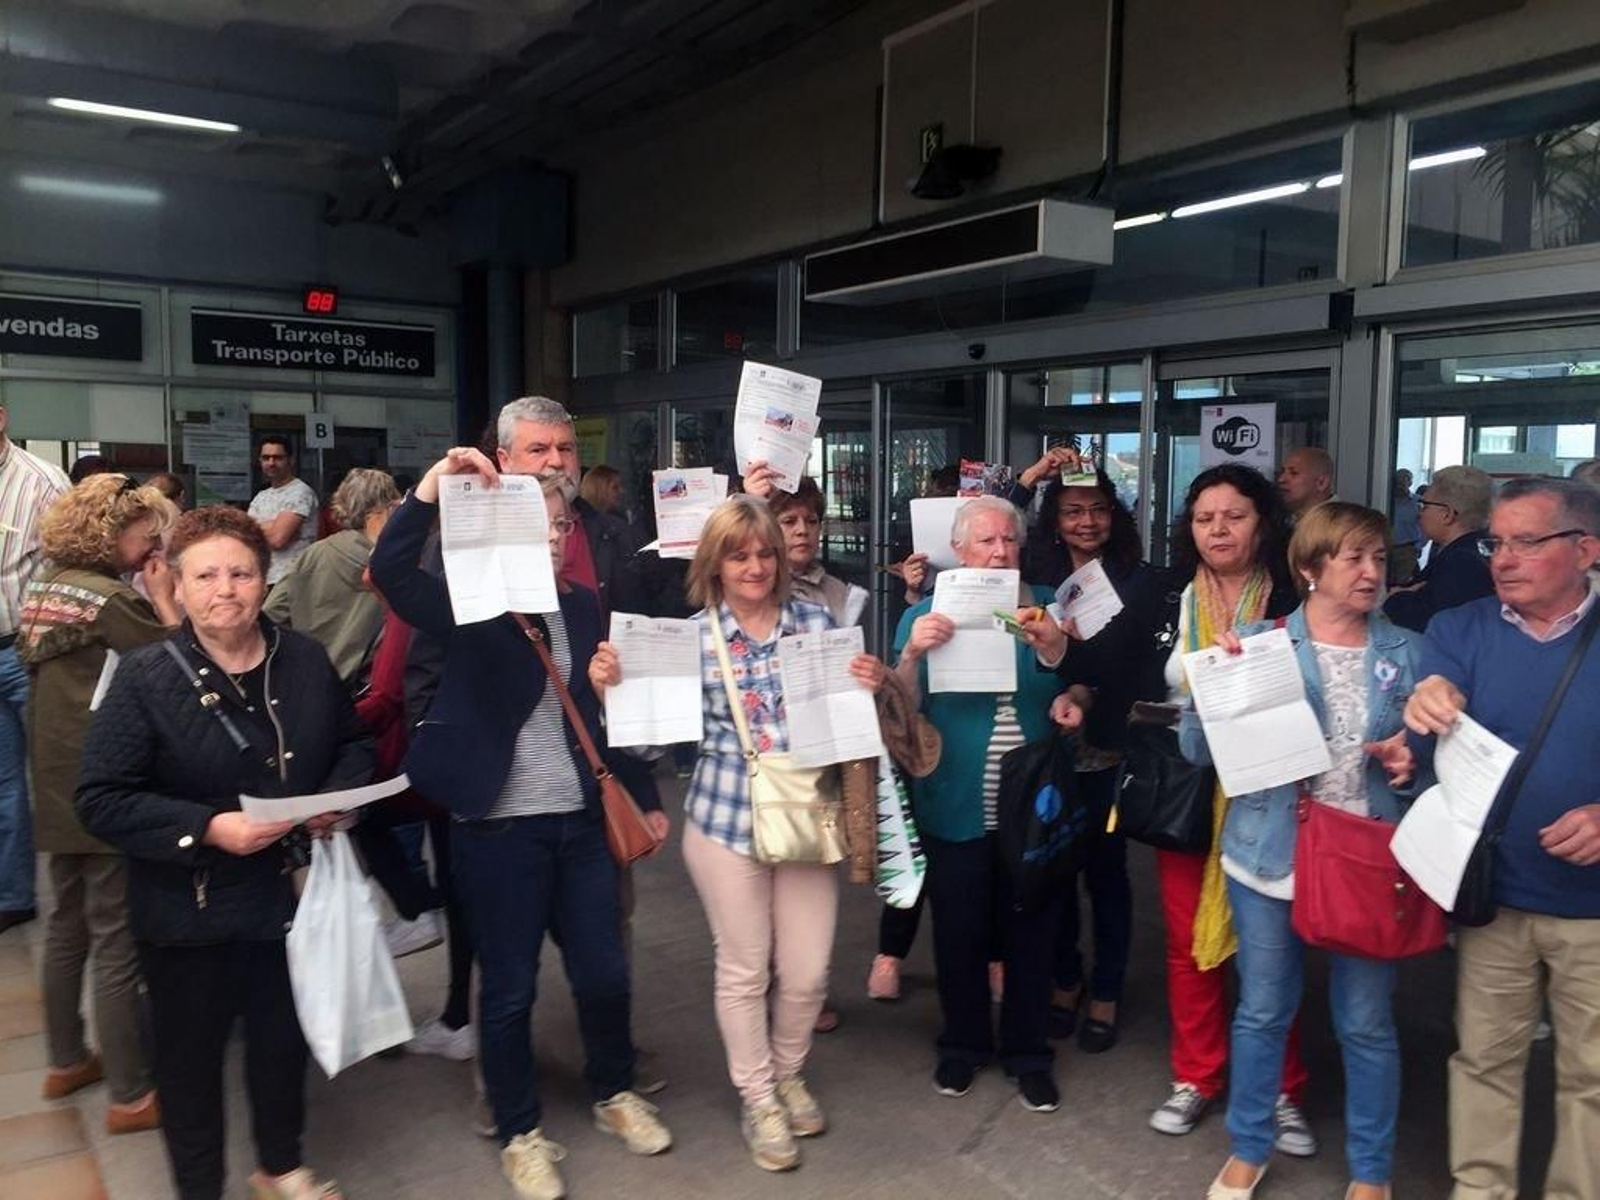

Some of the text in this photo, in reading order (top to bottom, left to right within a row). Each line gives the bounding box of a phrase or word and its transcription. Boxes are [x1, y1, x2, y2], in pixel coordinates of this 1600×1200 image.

[271, 323, 367, 347] Tarxetas
[212, 340, 420, 370] Transporte Público
[316, 423, 327, 438] B
